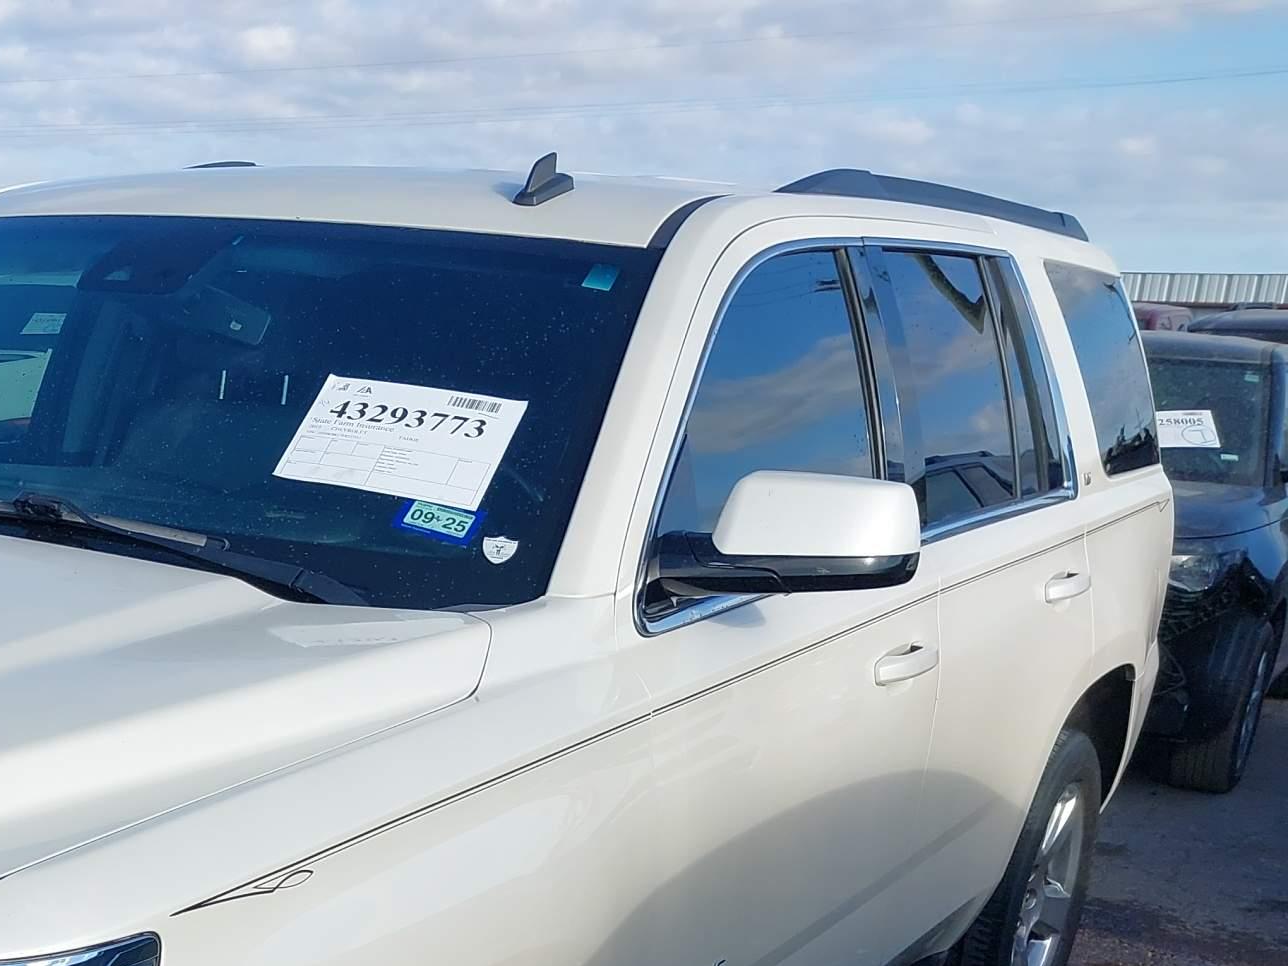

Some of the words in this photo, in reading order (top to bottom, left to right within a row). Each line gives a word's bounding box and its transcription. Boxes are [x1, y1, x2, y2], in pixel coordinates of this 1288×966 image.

[329, 400, 487, 439] 43293773
[410, 508, 435, 524] 09
[441, 517, 469, 533] 25
